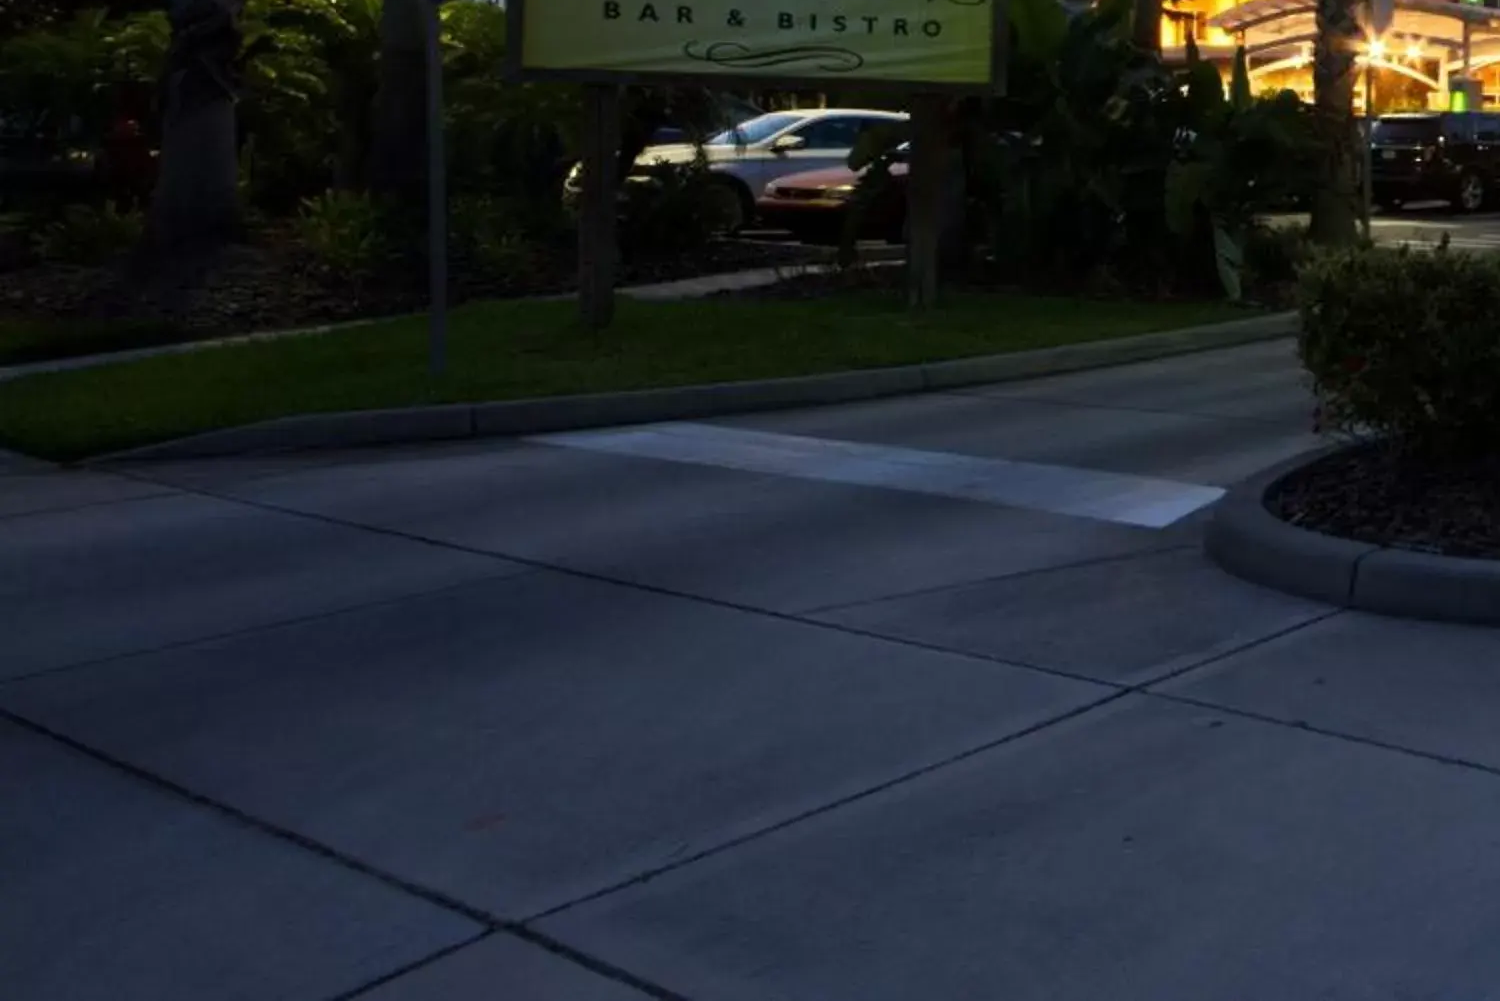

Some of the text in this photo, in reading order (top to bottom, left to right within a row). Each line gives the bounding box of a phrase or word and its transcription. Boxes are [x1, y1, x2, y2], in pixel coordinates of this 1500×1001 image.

[603, 0, 942, 37] BAR & BISTRO
